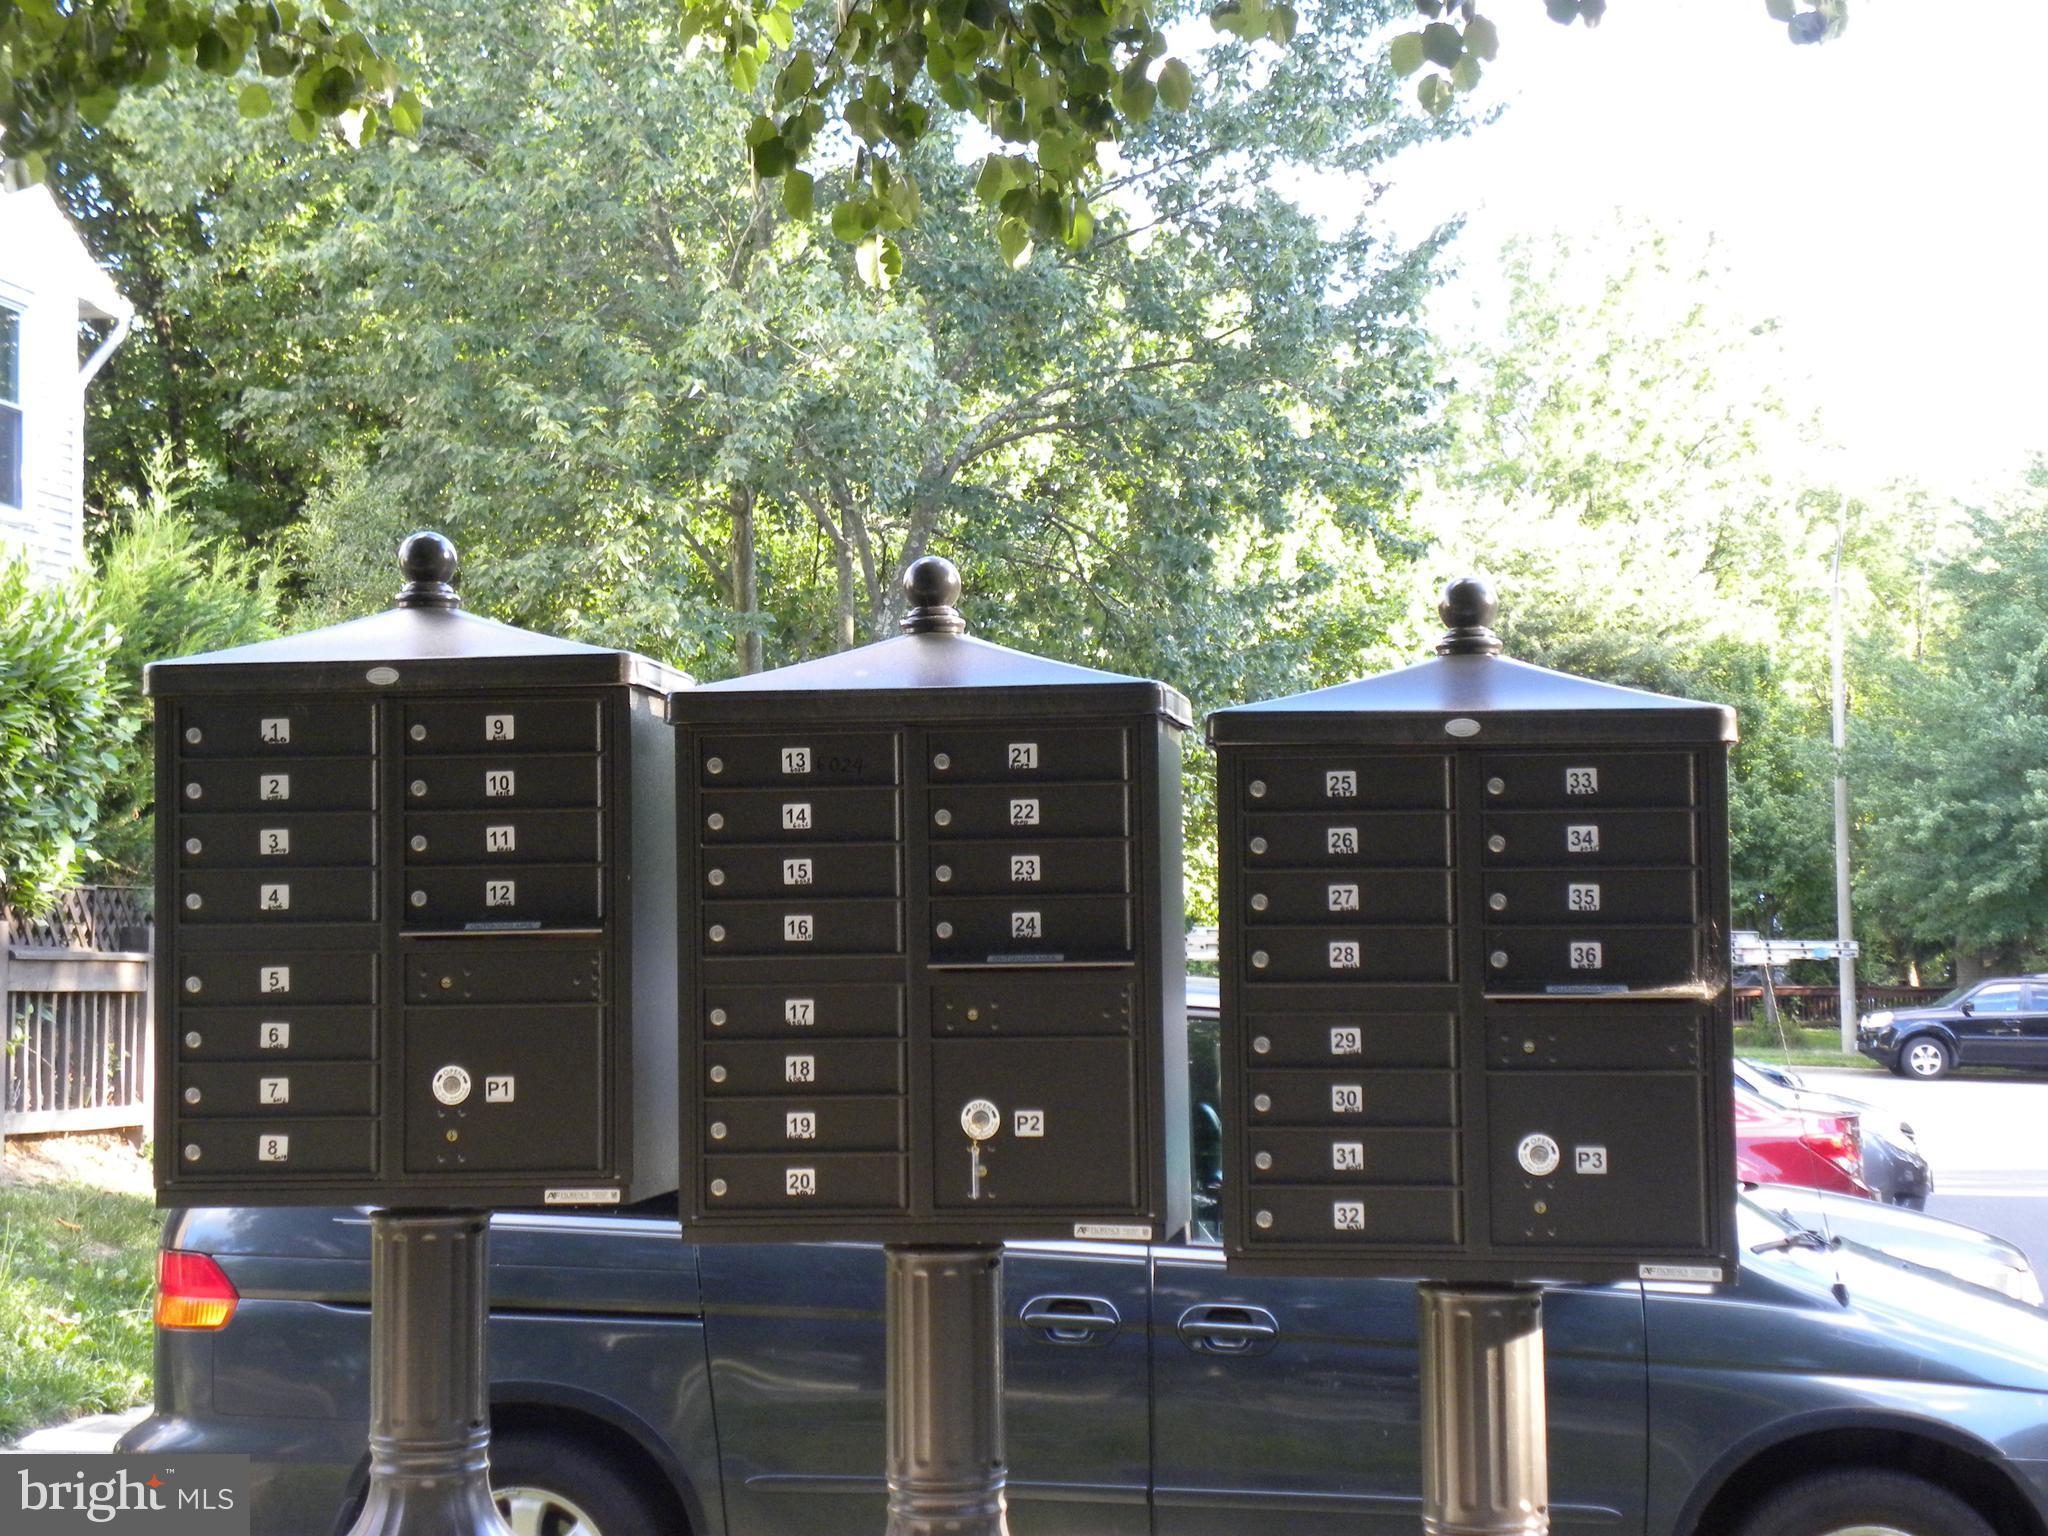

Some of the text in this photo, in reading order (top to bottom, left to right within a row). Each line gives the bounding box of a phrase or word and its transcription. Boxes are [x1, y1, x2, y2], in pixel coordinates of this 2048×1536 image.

[271, 723, 278, 738] 1
[494, 720, 504, 734] 9
[786, 753, 806, 768] 13
[1012, 748, 1031, 763] 21
[270, 780, 280, 794] 2
[489, 775, 510, 790] 10
[1330, 776, 1352, 791] 25
[1570, 773, 1592, 789] 33
[786, 808, 807, 823] 14
[1013, 804, 1034, 819] 22
[269, 834, 279, 849] 3
[490, 831, 508, 846] 11
[1331, 833, 1353, 848] 26
[1571, 831, 1593, 846] 34
[787, 864, 808, 879] 15
[1014, 861, 1035, 876] 23
[269, 889, 279, 903] 4
[490, 886, 510, 901] 12
[1332, 890, 1353, 905] 27
[1573, 889, 1595, 905] 35
[788, 920, 808, 935] 16
[1015, 917, 1036, 933] 24
[1333, 947, 1354, 963] 28
[1574, 948, 1596, 963] 36
[270, 972, 279, 987] 5
[790, 1005, 810, 1020] 17
[269, 1028, 279, 1043] 6
[1335, 1033, 1356, 1048] 29
[443, 1068, 463, 1077] OPEN
[790, 1061, 810, 1076] 18
[268, 1083, 278, 1098] 7
[488, 1081, 508, 1096] P1
[1336, 1091, 1357, 1106] 30
[972, 1102, 992, 1112] OPEN
[790, 1118, 811, 1133] 19
[1017, 1116, 1040, 1131] P2
[268, 1140, 277, 1155] 8
[1531, 1137, 1551, 1147] OPEN
[1337, 1148, 1356, 1164] 31
[1579, 1152, 1603, 1168] P3
[790, 1174, 810, 1189] 20
[1338, 1208, 1359, 1224] 32
